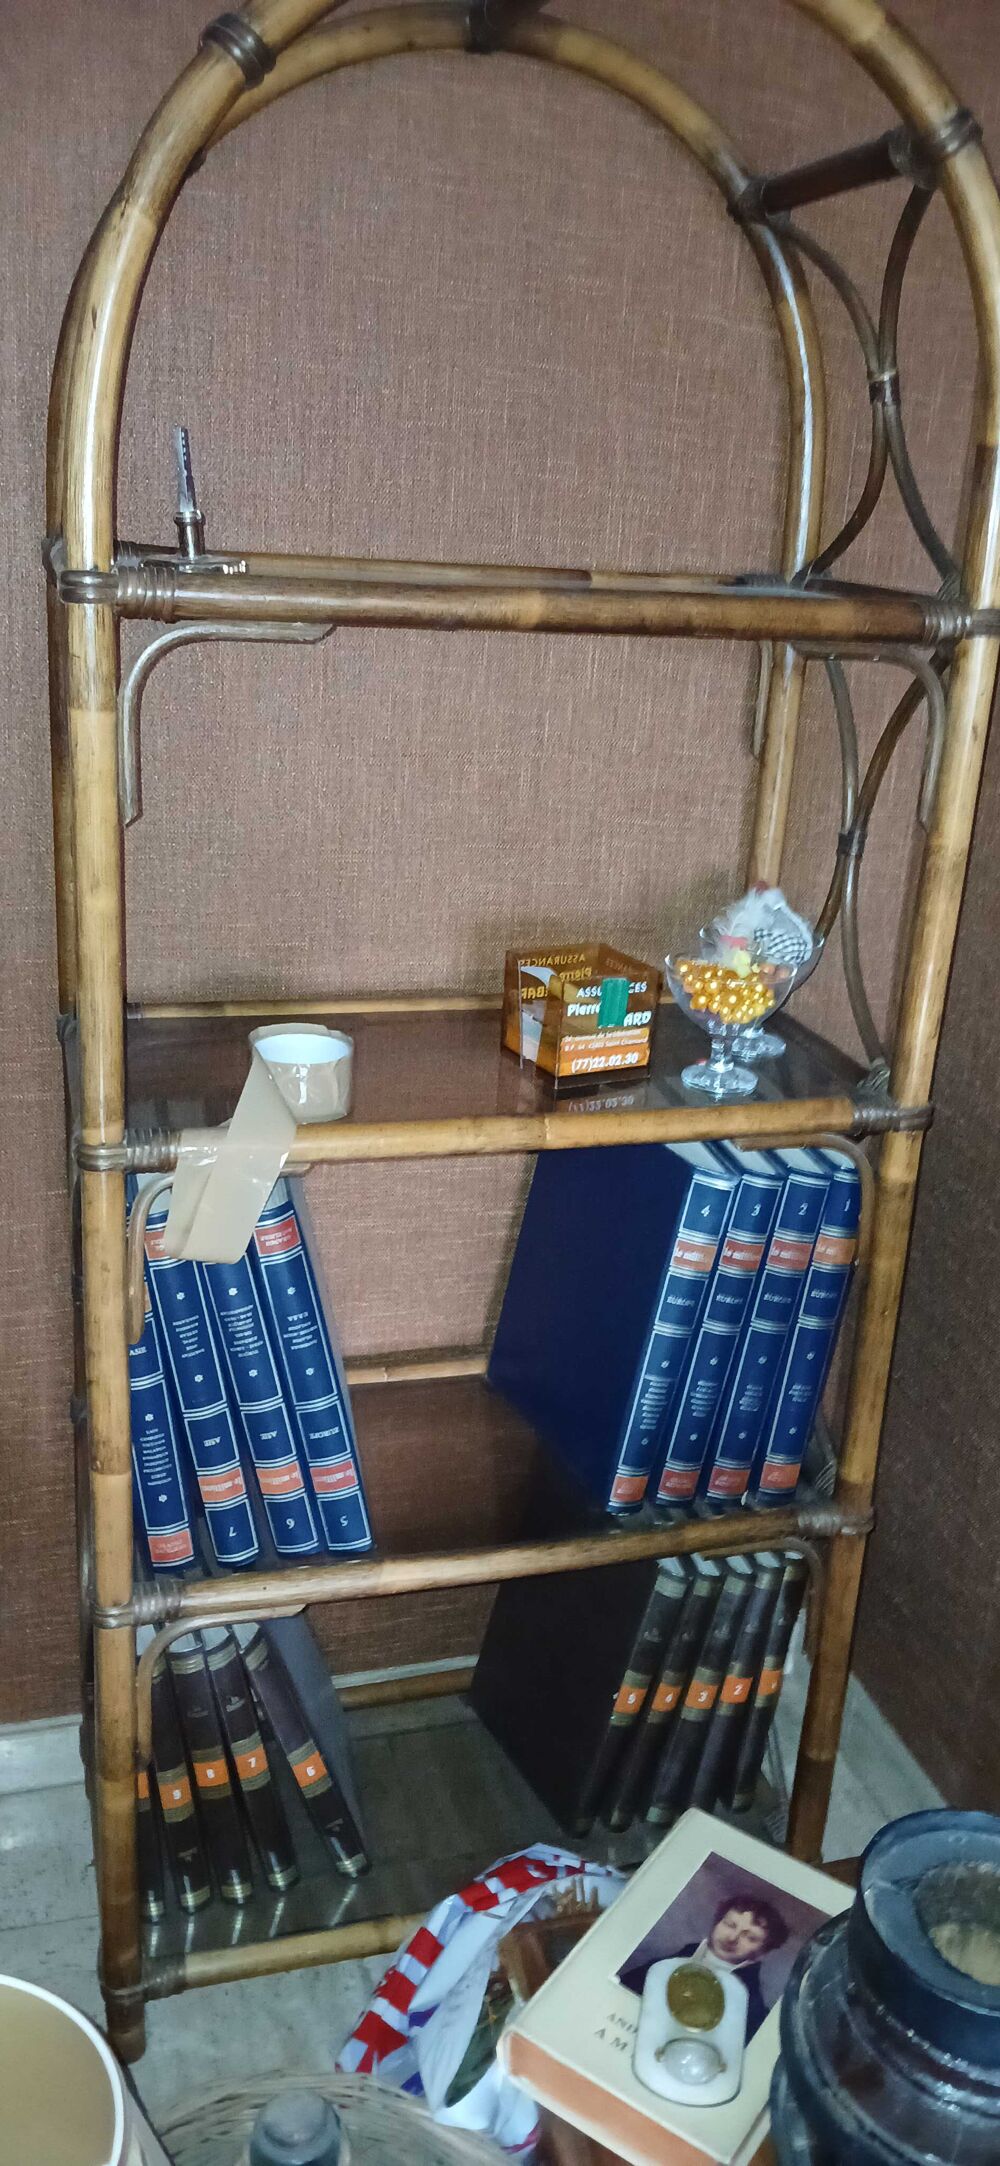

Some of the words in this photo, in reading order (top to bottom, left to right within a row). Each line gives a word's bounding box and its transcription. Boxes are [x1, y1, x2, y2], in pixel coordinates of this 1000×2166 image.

[576, 981, 648, 999] ASSUCES
[571, 1051, 639, 1073] (77)22.02.30
[701, 1205, 710, 1217] 4
[751, 1204, 761, 1216] 3
[798, 1202, 808, 1215] 2
[843, 1199, 851, 1211] 1
[340, 1516, 349, 1527] 5
[228, 1527, 237, 1537] 7
[733, 1684, 743, 1695] 2
[698, 1690, 708, 1703] 3
[248, 1757, 257, 1768] 7
